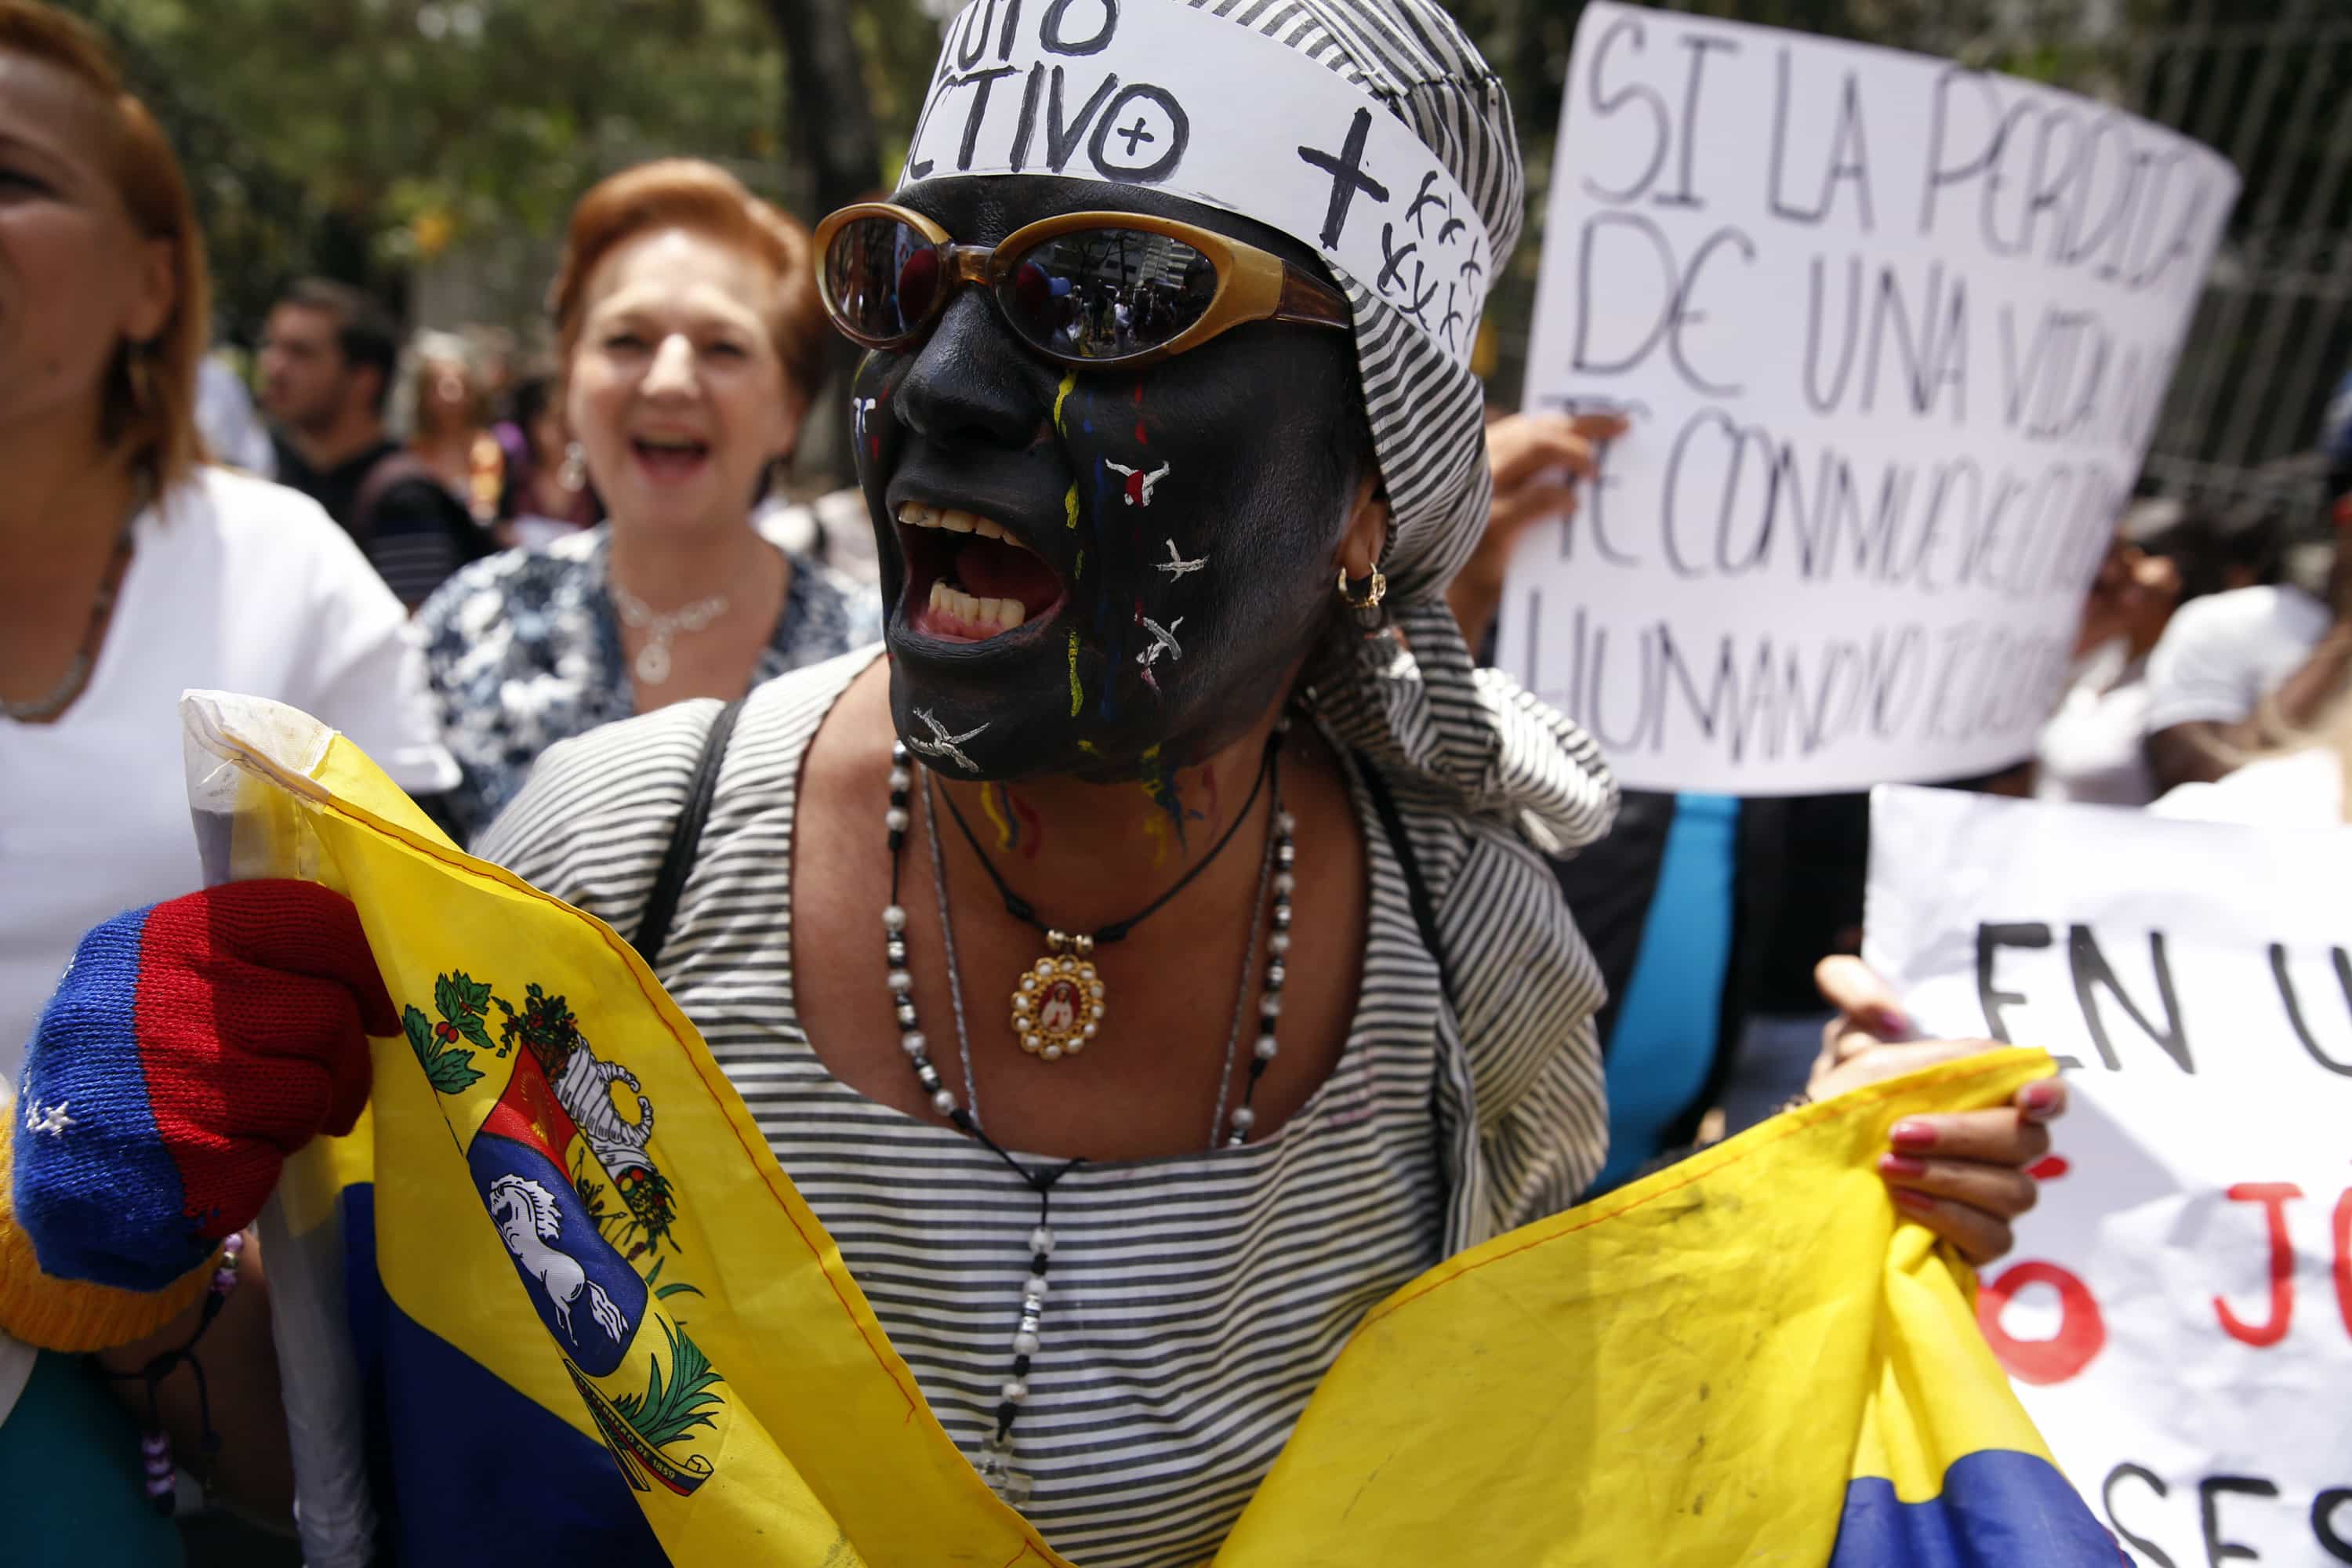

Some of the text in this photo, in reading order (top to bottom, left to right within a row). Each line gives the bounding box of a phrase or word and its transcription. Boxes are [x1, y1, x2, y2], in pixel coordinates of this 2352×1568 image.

[902, 61, 1190, 185] CTIVO
[1582, 14, 1738, 209] SI
[1769, 47, 1876, 233] LA
[1572, 210, 1756, 396] DE
[1803, 252, 1969, 427] UNA
[1539, 394, 1652, 568] TE
[1976, 921, 2197, 1075] EN
[2212, 1181, 2352, 1348] J
